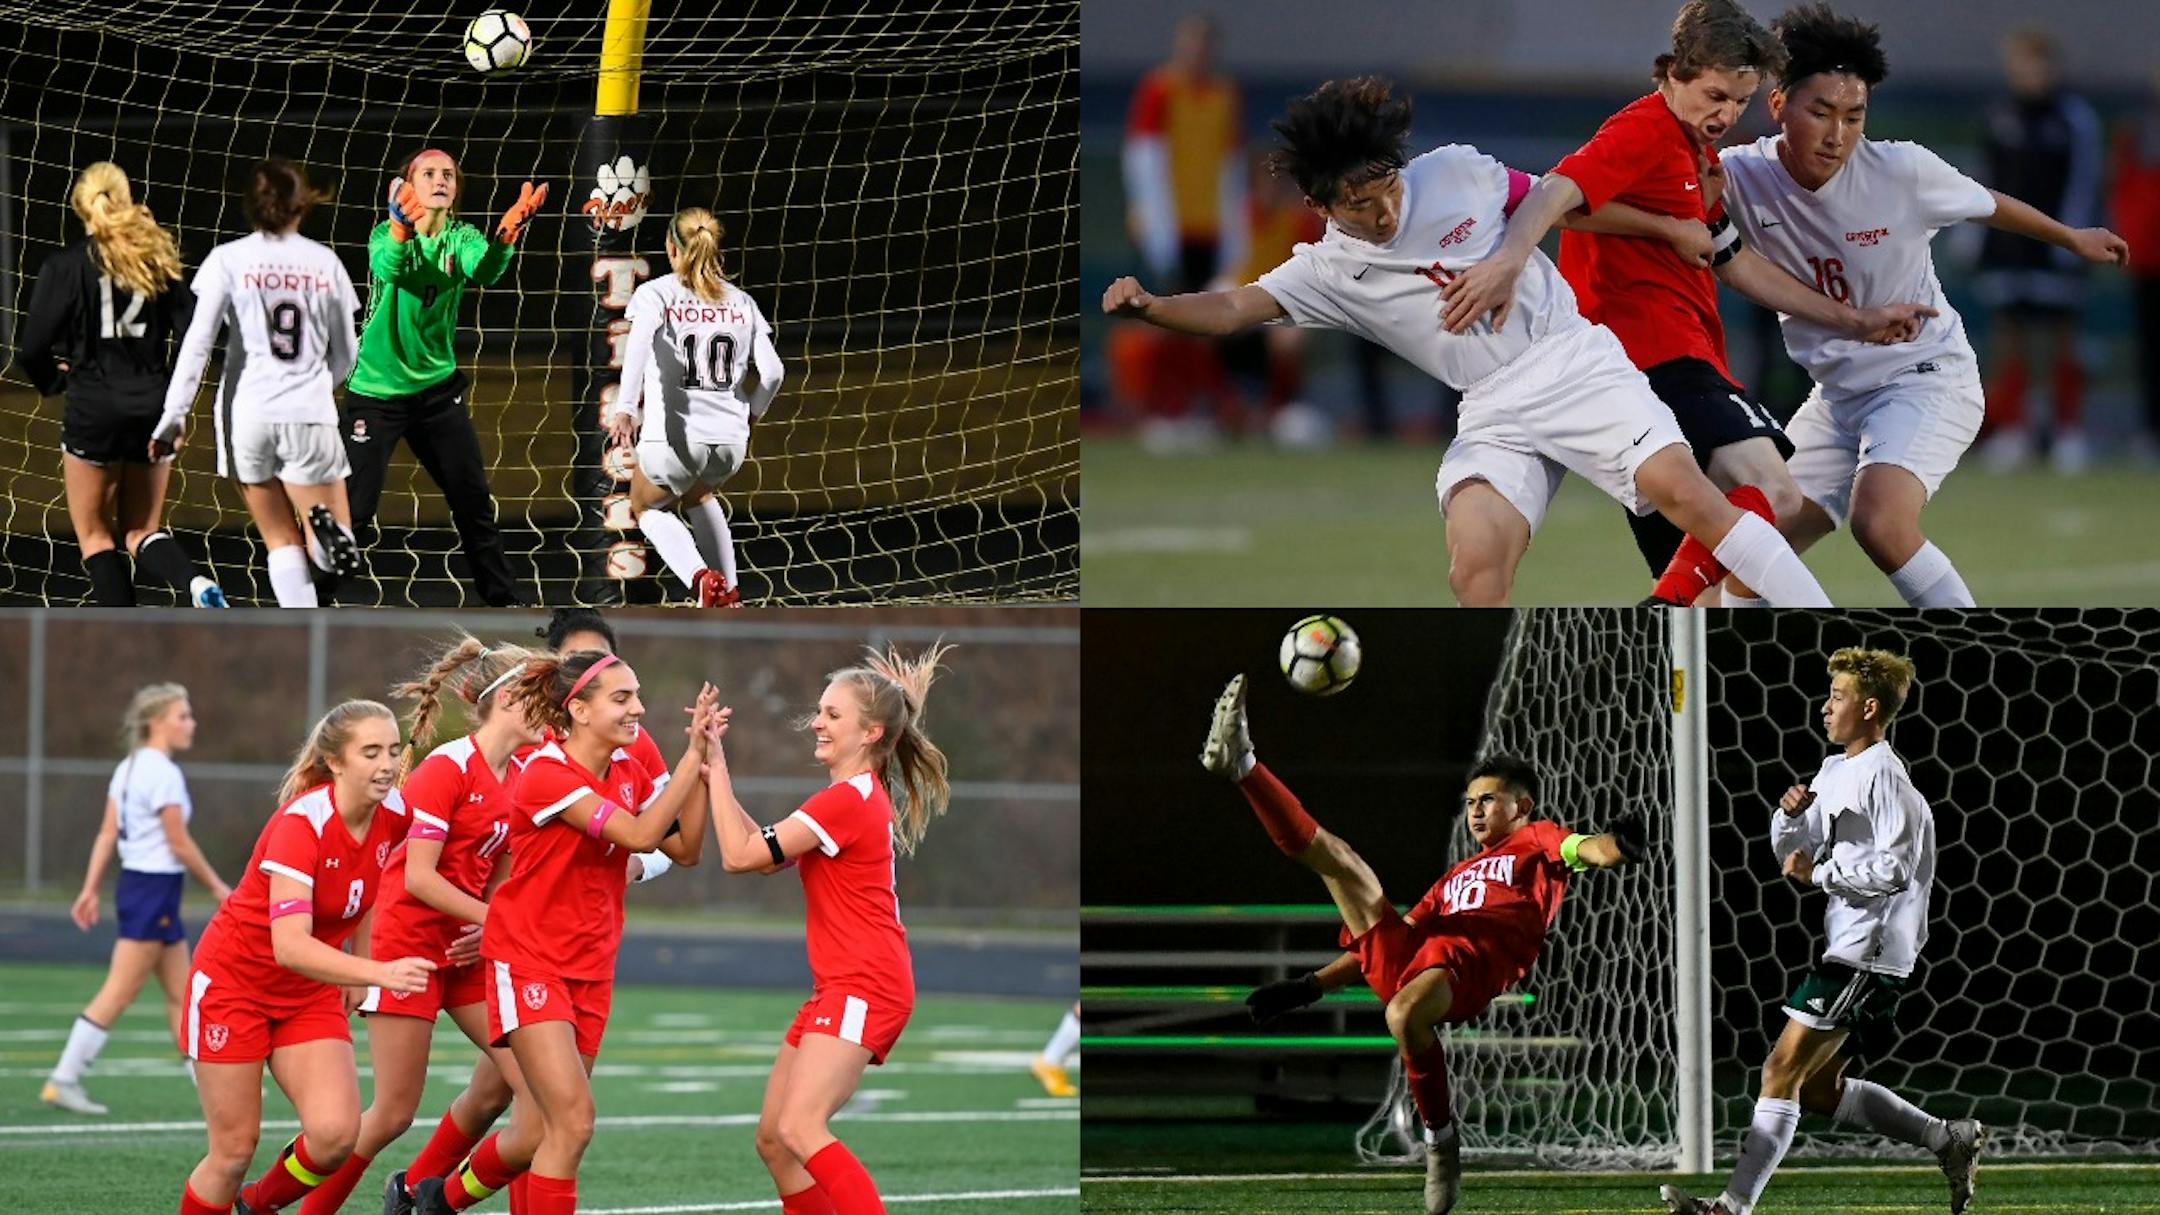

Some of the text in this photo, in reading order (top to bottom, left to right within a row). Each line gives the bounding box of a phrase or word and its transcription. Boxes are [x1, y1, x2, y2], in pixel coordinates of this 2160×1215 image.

[244, 273, 330, 294] NORTH
[1807, 256, 1849, 303] 16
[98, 272, 147, 339] 12
[666, 308, 746, 325] NORTH
[271, 302, 303, 362] 9
[681, 331, 738, 392] 10
[477, 820, 510, 858] 11
[342, 879, 364, 919] 8
